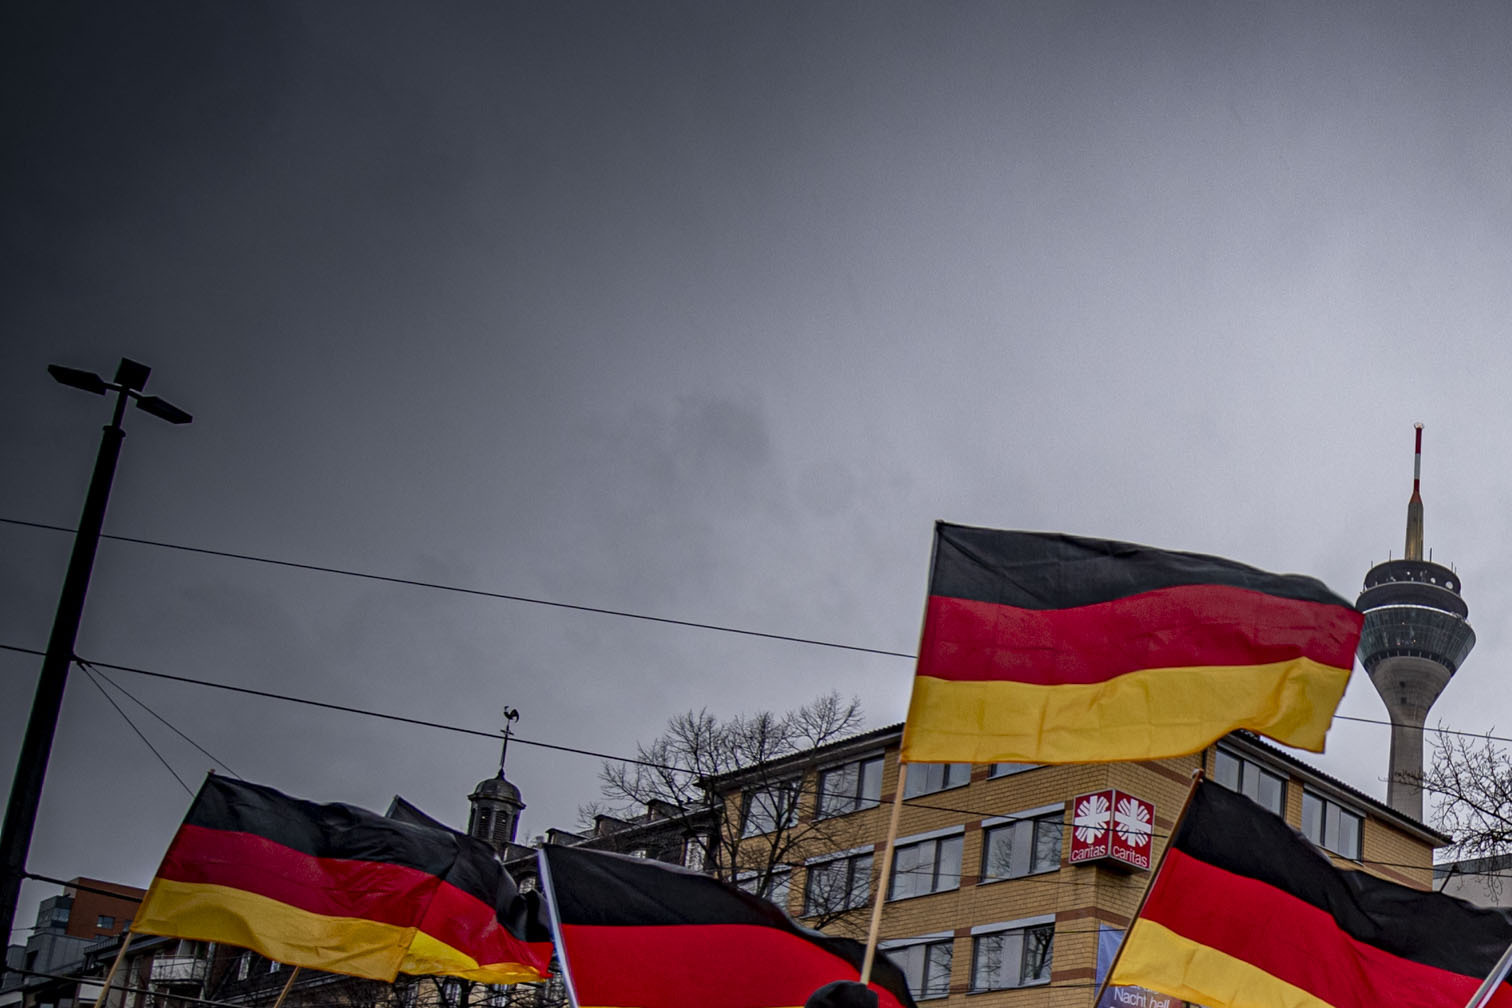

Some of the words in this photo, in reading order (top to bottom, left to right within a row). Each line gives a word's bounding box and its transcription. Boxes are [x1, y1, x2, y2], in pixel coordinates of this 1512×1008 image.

[1072, 845, 1106, 860] caritas
[1113, 846, 1148, 867] caritas
[1114, 987, 1147, 1008] Nacht
